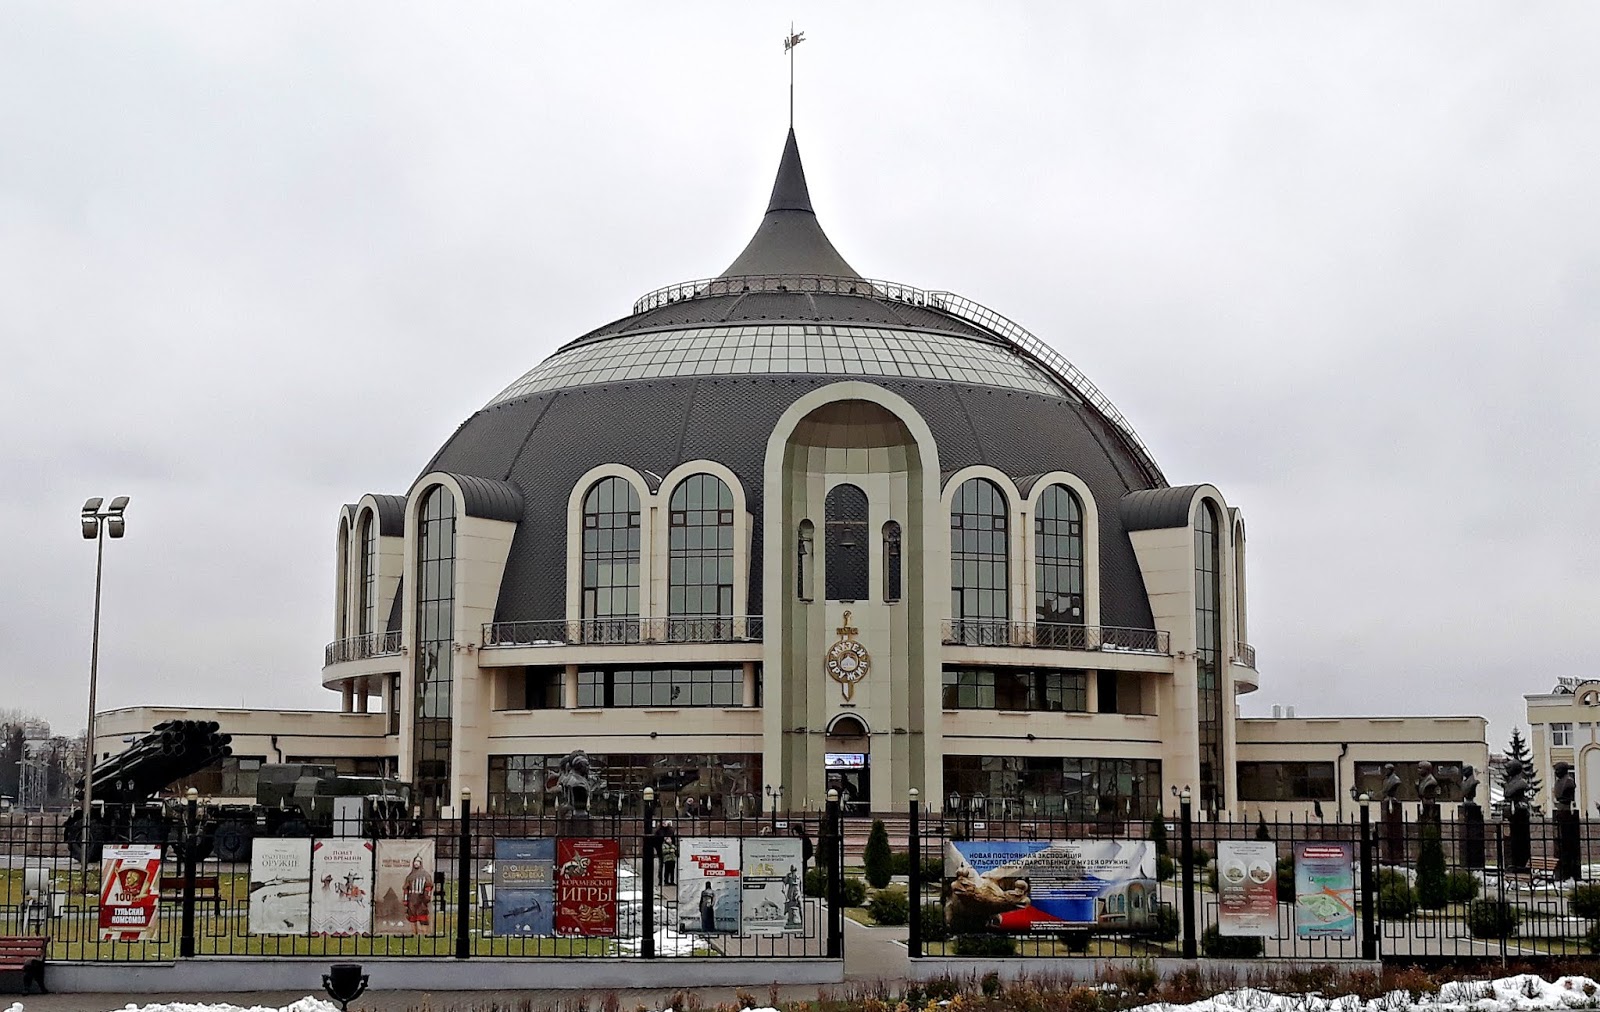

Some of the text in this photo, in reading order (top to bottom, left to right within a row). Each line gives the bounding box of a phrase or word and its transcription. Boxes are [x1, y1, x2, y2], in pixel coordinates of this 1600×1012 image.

[831, 641, 866, 657] МУЗЕЙ
[829, 661, 868, 681] ОРУЖИЯ
[1008, 859, 1076, 867] ГОСУДАРСТВЕННОГО
[114, 893, 131, 902] 100
[562, 887, 614, 902] ИГРЫ
[114, 907, 144, 916] ТУЛЬСКИЙ
[111, 916, 146, 924] КОМСОМОЛ
